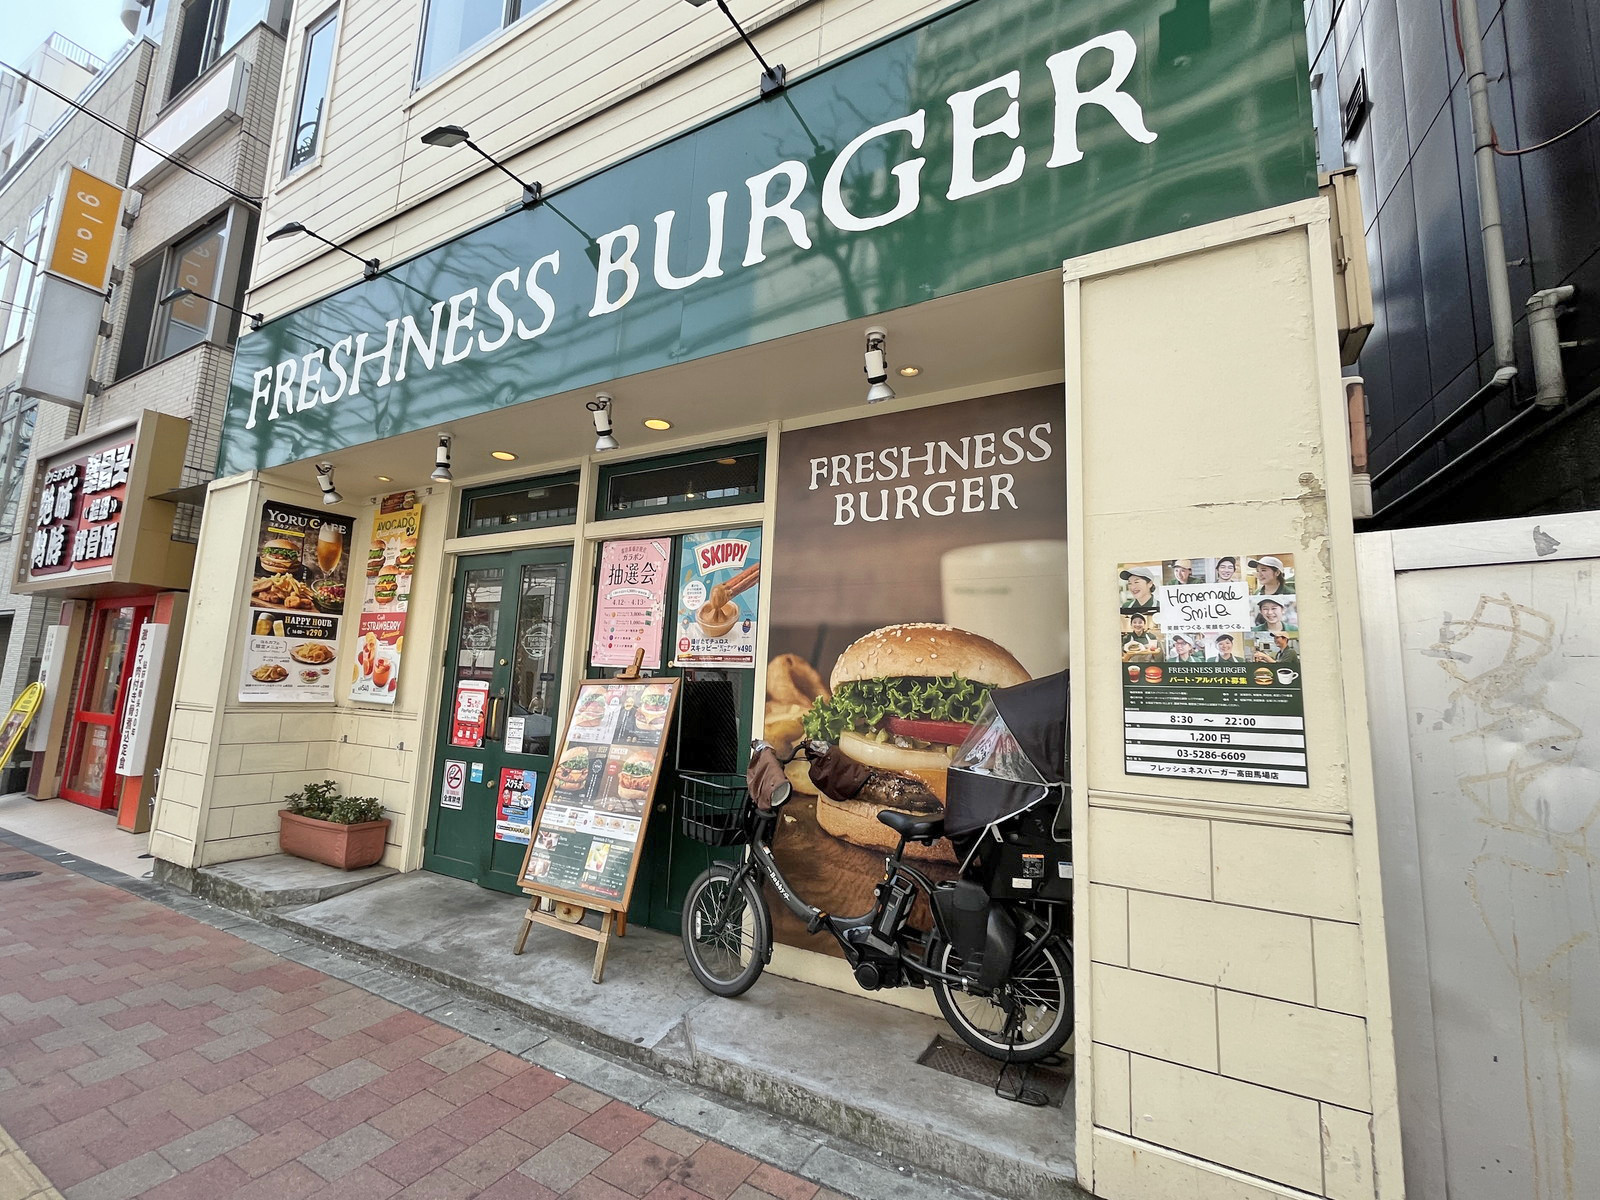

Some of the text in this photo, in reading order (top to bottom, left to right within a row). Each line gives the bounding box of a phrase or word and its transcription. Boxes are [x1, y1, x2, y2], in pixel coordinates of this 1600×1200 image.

[245, 30, 1158, 430] FRESHNESS BURGER
[808, 422, 1052, 490] FRESHNESS
[833, 473, 1018, 526] BURGER
[267, 509, 307, 527] YORU
[376, 516, 416, 531] AVOCADO
[701, 542, 748, 569] SKIPPY
[608, 561, 657, 586] 抽選会
[1166, 585, 1243, 607] Homemade
[284, 616, 333, 628] HAPPY HOUR
[1168, 666, 1247, 674] FRESHNESS BURGER
[1169, 715, 1194, 724] 8:30
[1224, 716, 1256, 727] 22:00
[1189, 732, 1218, 743] 1,200
[1176, 749, 1247, 761] 03-5286-6609
[1149, 764, 1280, 781] フレッシュネスバーガー高田馬場店
